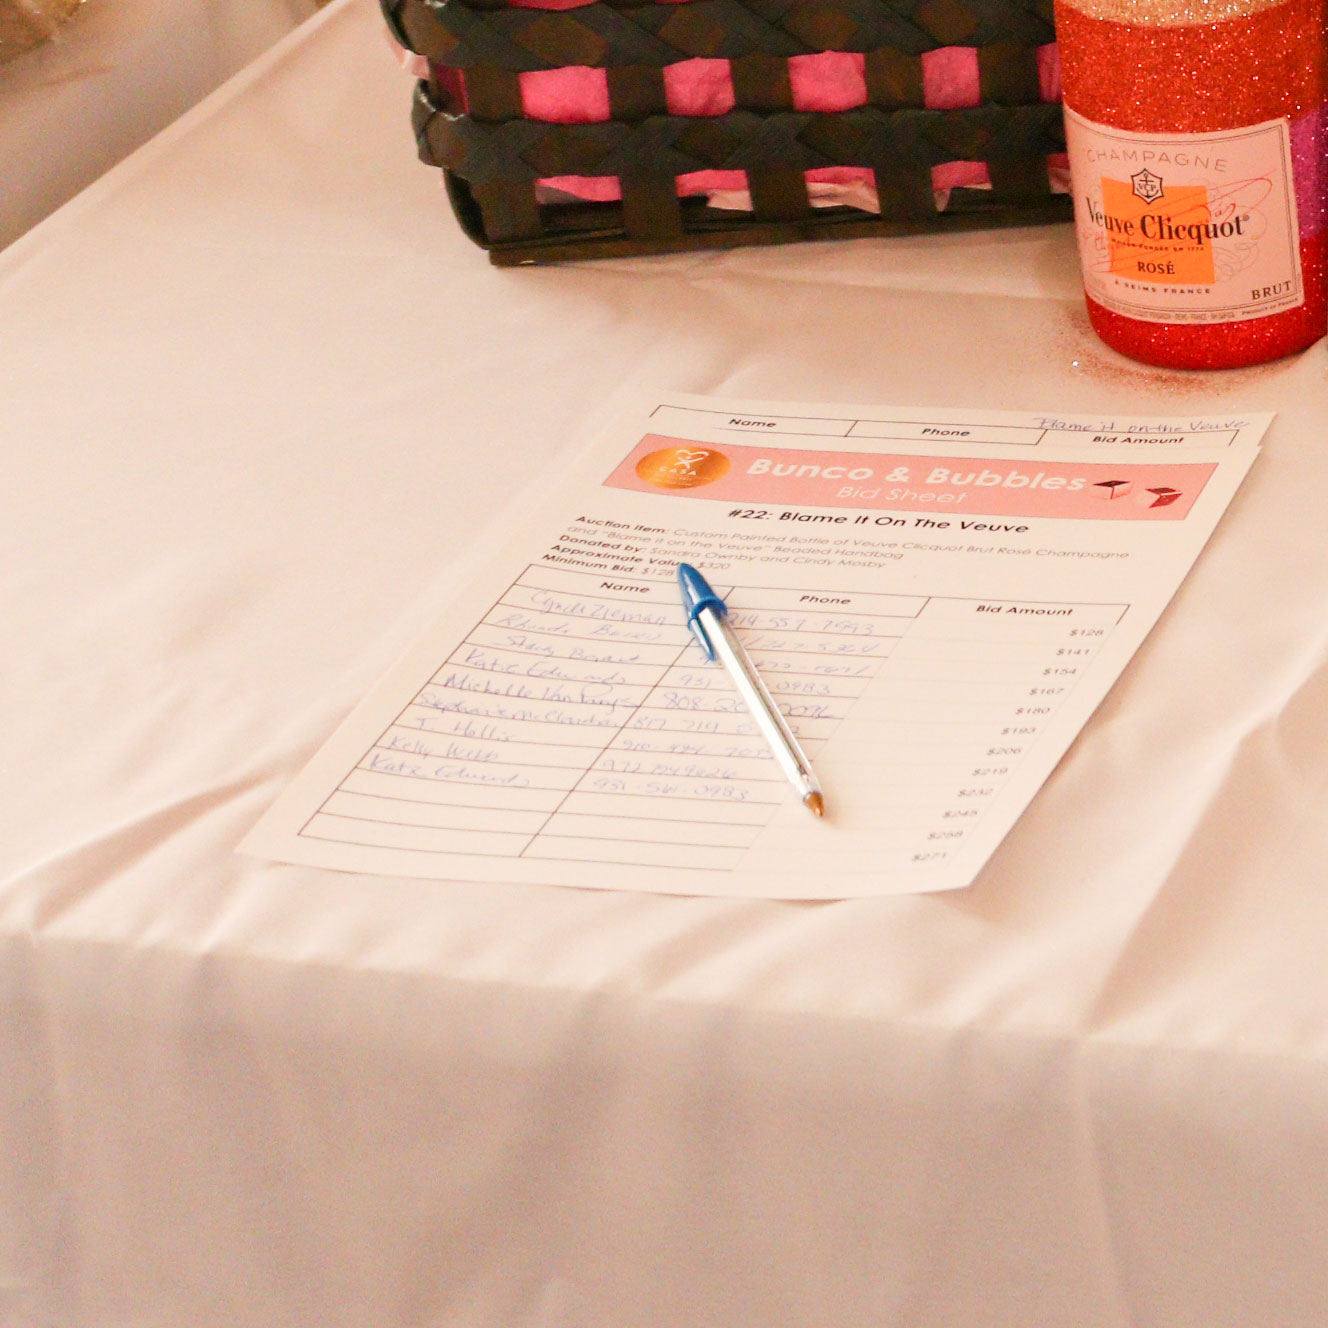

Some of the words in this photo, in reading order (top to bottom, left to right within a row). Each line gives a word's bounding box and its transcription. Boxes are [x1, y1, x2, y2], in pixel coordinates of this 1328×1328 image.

[1087, 149, 1228, 172] CHAMPAGNE
[1085, 196, 1133, 235] Veuve
[1140, 214, 1244, 245] Clicquot
[1138, 260, 1175, 275] ROSÉ
[1252, 281, 1292, 301] BRUT
[729, 418, 776, 428] Name
[921, 428, 970, 438] Phone
[1092, 435, 1117, 444] Bid
[1120, 436, 1184, 445] Amount
[746, 459, 873, 481] Bunco
[885, 467, 910, 483] &
[925, 468, 1087, 491] Bubbles
[836, 486, 878, 499] Bid
[885, 488, 968, 503] Sheet
[728, 509, 772, 520] #22:
[779, 511, 847, 524] Blame
[854, 515, 869, 524] It
[875, 516, 907, 527] On
[914, 519, 951, 530] The
[959, 521, 1029, 533] Veuve
[551, 544, 643, 564] Approximate
[559, 535, 628, 550] Donated
[600, 582, 650, 593] Name
[800, 595, 851, 605] Phone
[976, 605, 1001, 613] Bid
[1006, 607, 1073, 616] Amount
